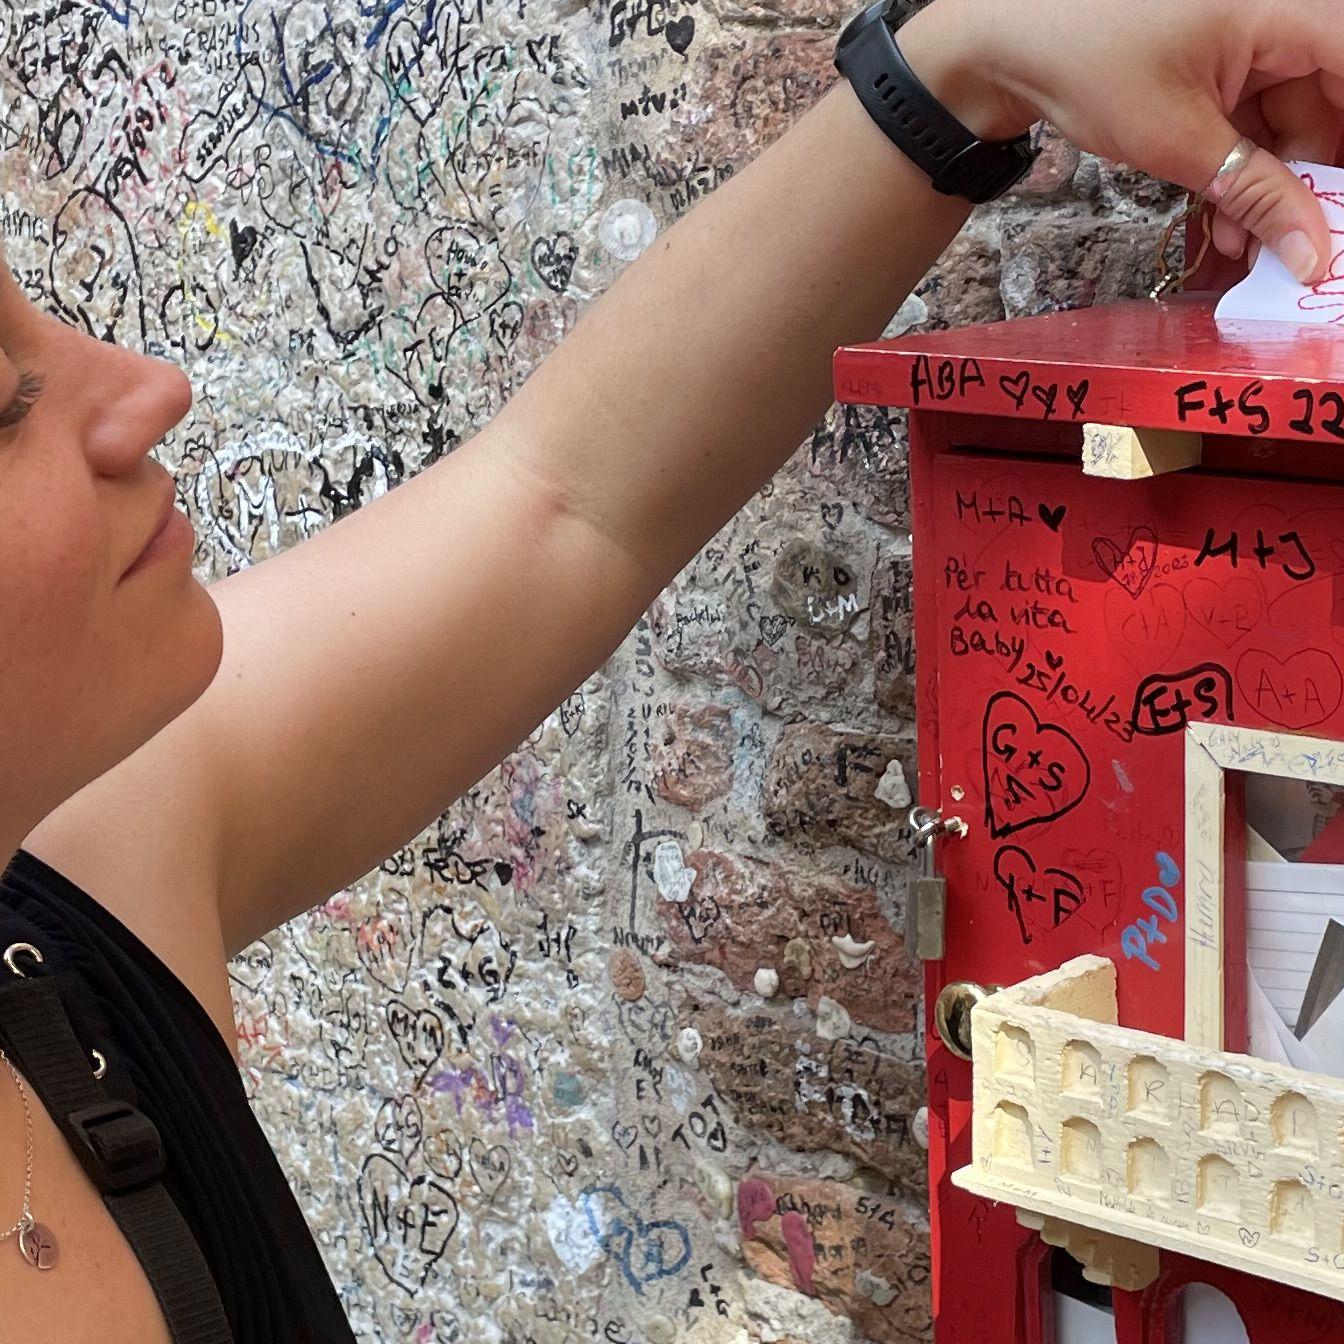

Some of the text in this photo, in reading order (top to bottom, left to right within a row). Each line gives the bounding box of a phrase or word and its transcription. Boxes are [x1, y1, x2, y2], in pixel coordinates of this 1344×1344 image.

[910, 355, 986, 405] ABA
[1000, 559, 1078, 603] tutta
[1010, 599, 1077, 634] vita
[950, 626, 1024, 673] Baby
